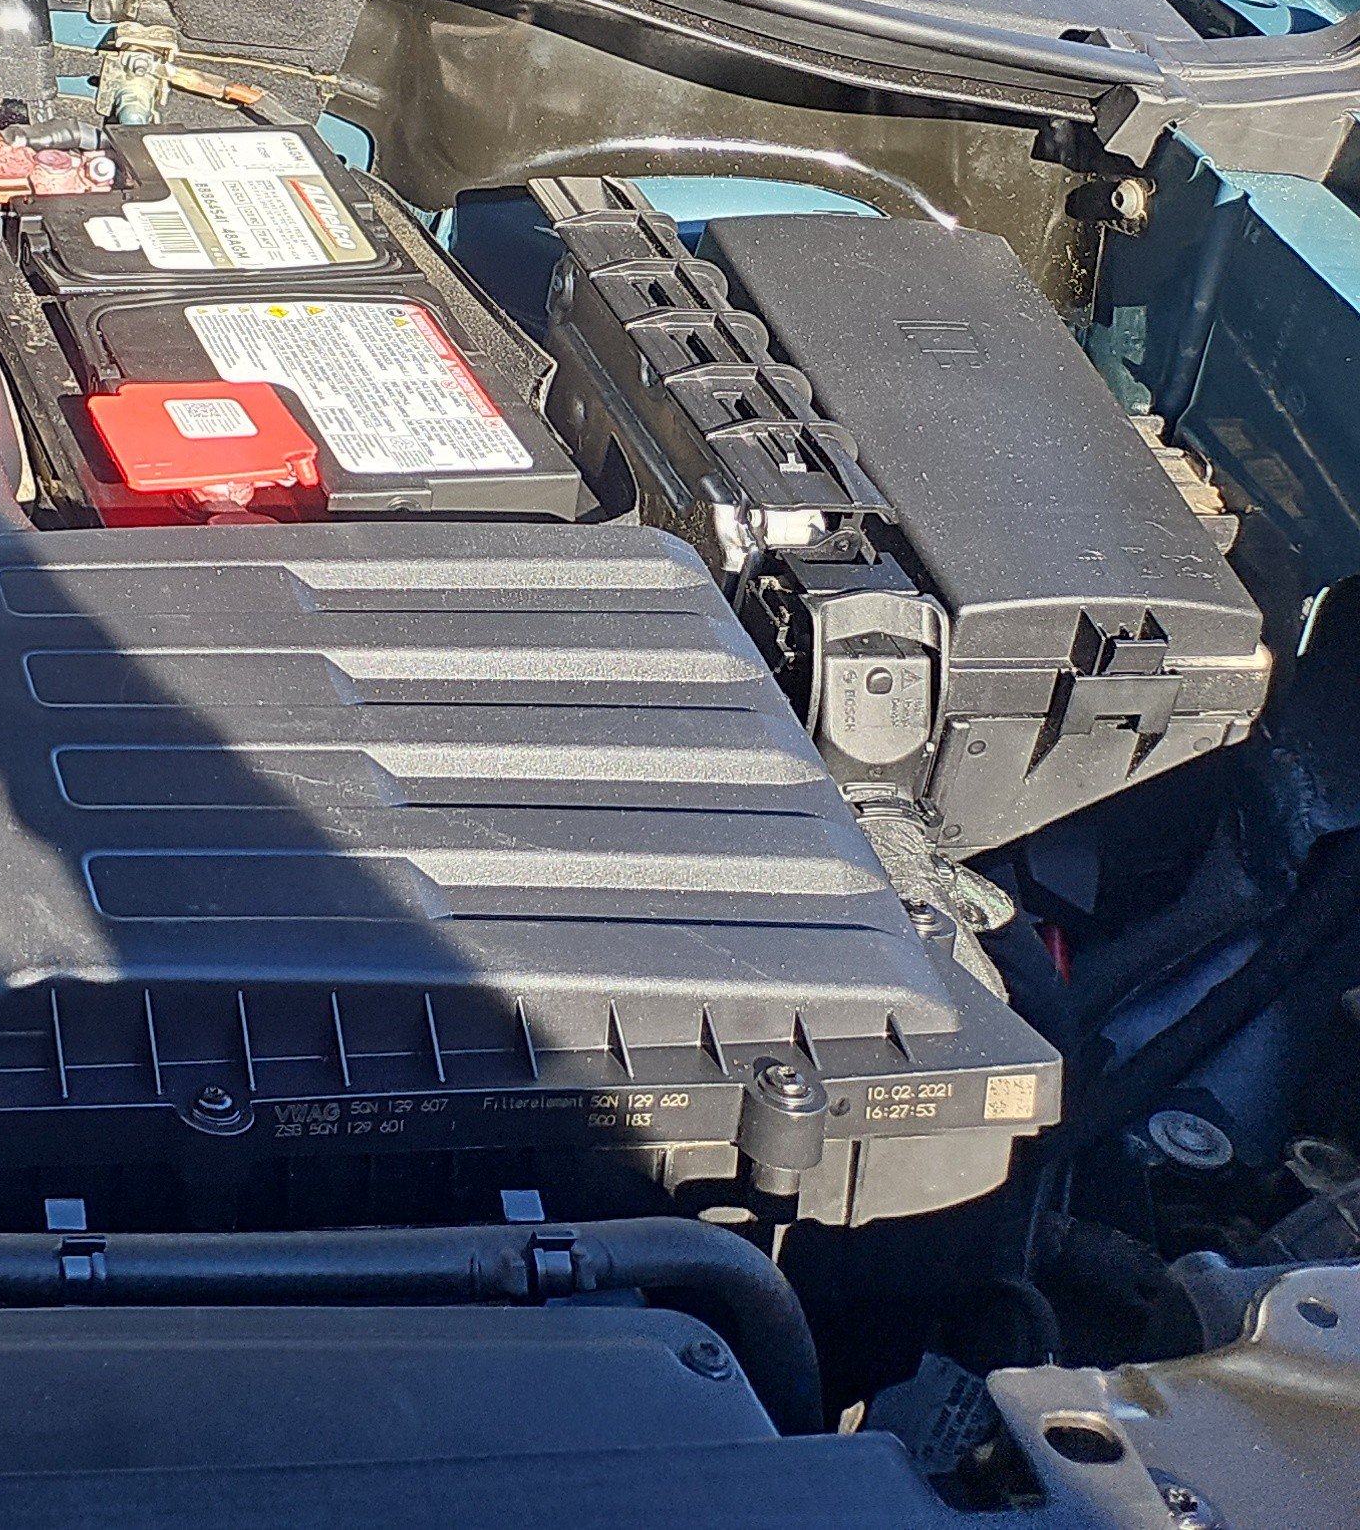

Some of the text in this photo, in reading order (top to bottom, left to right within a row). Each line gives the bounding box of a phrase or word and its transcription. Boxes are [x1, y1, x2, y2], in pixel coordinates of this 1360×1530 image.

[299, 181, 357, 250] ACDelco
[221, 227, 250, 260] 48AGM
[844, 689, 857, 732] BOSCH
[627, 1094, 653, 1108] 129
[659, 1093, 690, 1107] 620
[867, 1083, 953, 1101] 10.02.2021
[274, 1102, 341, 1123] VWAG
[388, 1100, 414, 1112] 129
[421, 1098, 449, 1112] 607
[865, 1103, 936, 1119] 16:27:53
[347, 1121, 372, 1134] 129
[380, 1120, 405, 1133] 601
[626, 1113, 653, 1127] 183
